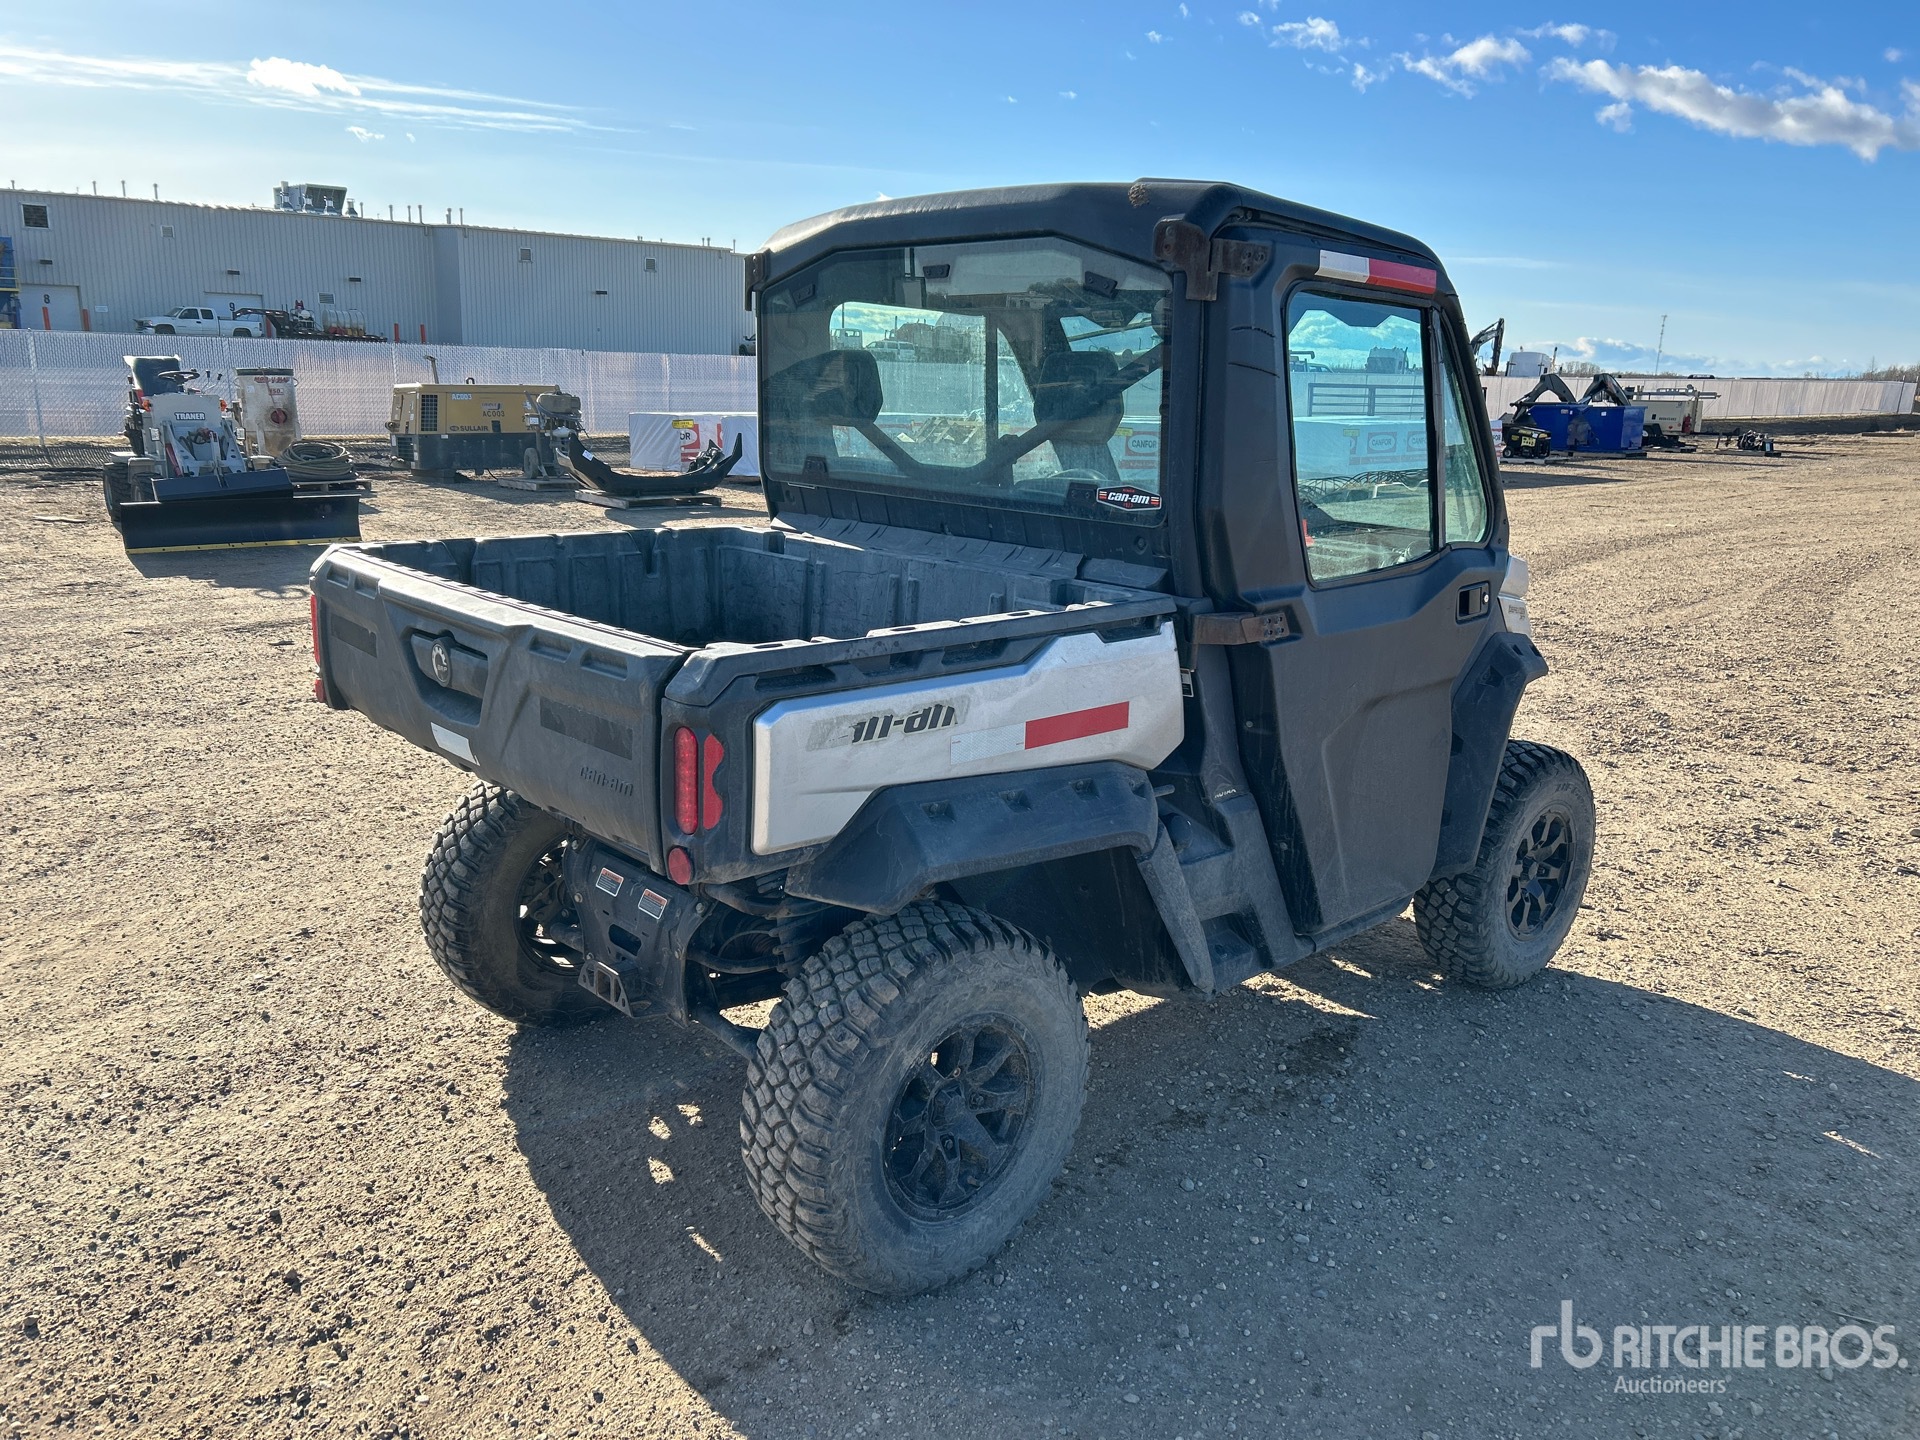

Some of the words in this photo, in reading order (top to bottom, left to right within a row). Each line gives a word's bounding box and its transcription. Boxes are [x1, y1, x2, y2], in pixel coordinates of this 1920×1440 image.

[43, 294, 51, 304] 8
[229, 302, 236, 311] 9
[175, 412, 205, 420] TRANER
[1131, 439, 1157, 449] CANFOR
[1371, 439, 1392, 447] CANFOR
[1108, 492, 1150, 504] can-am
